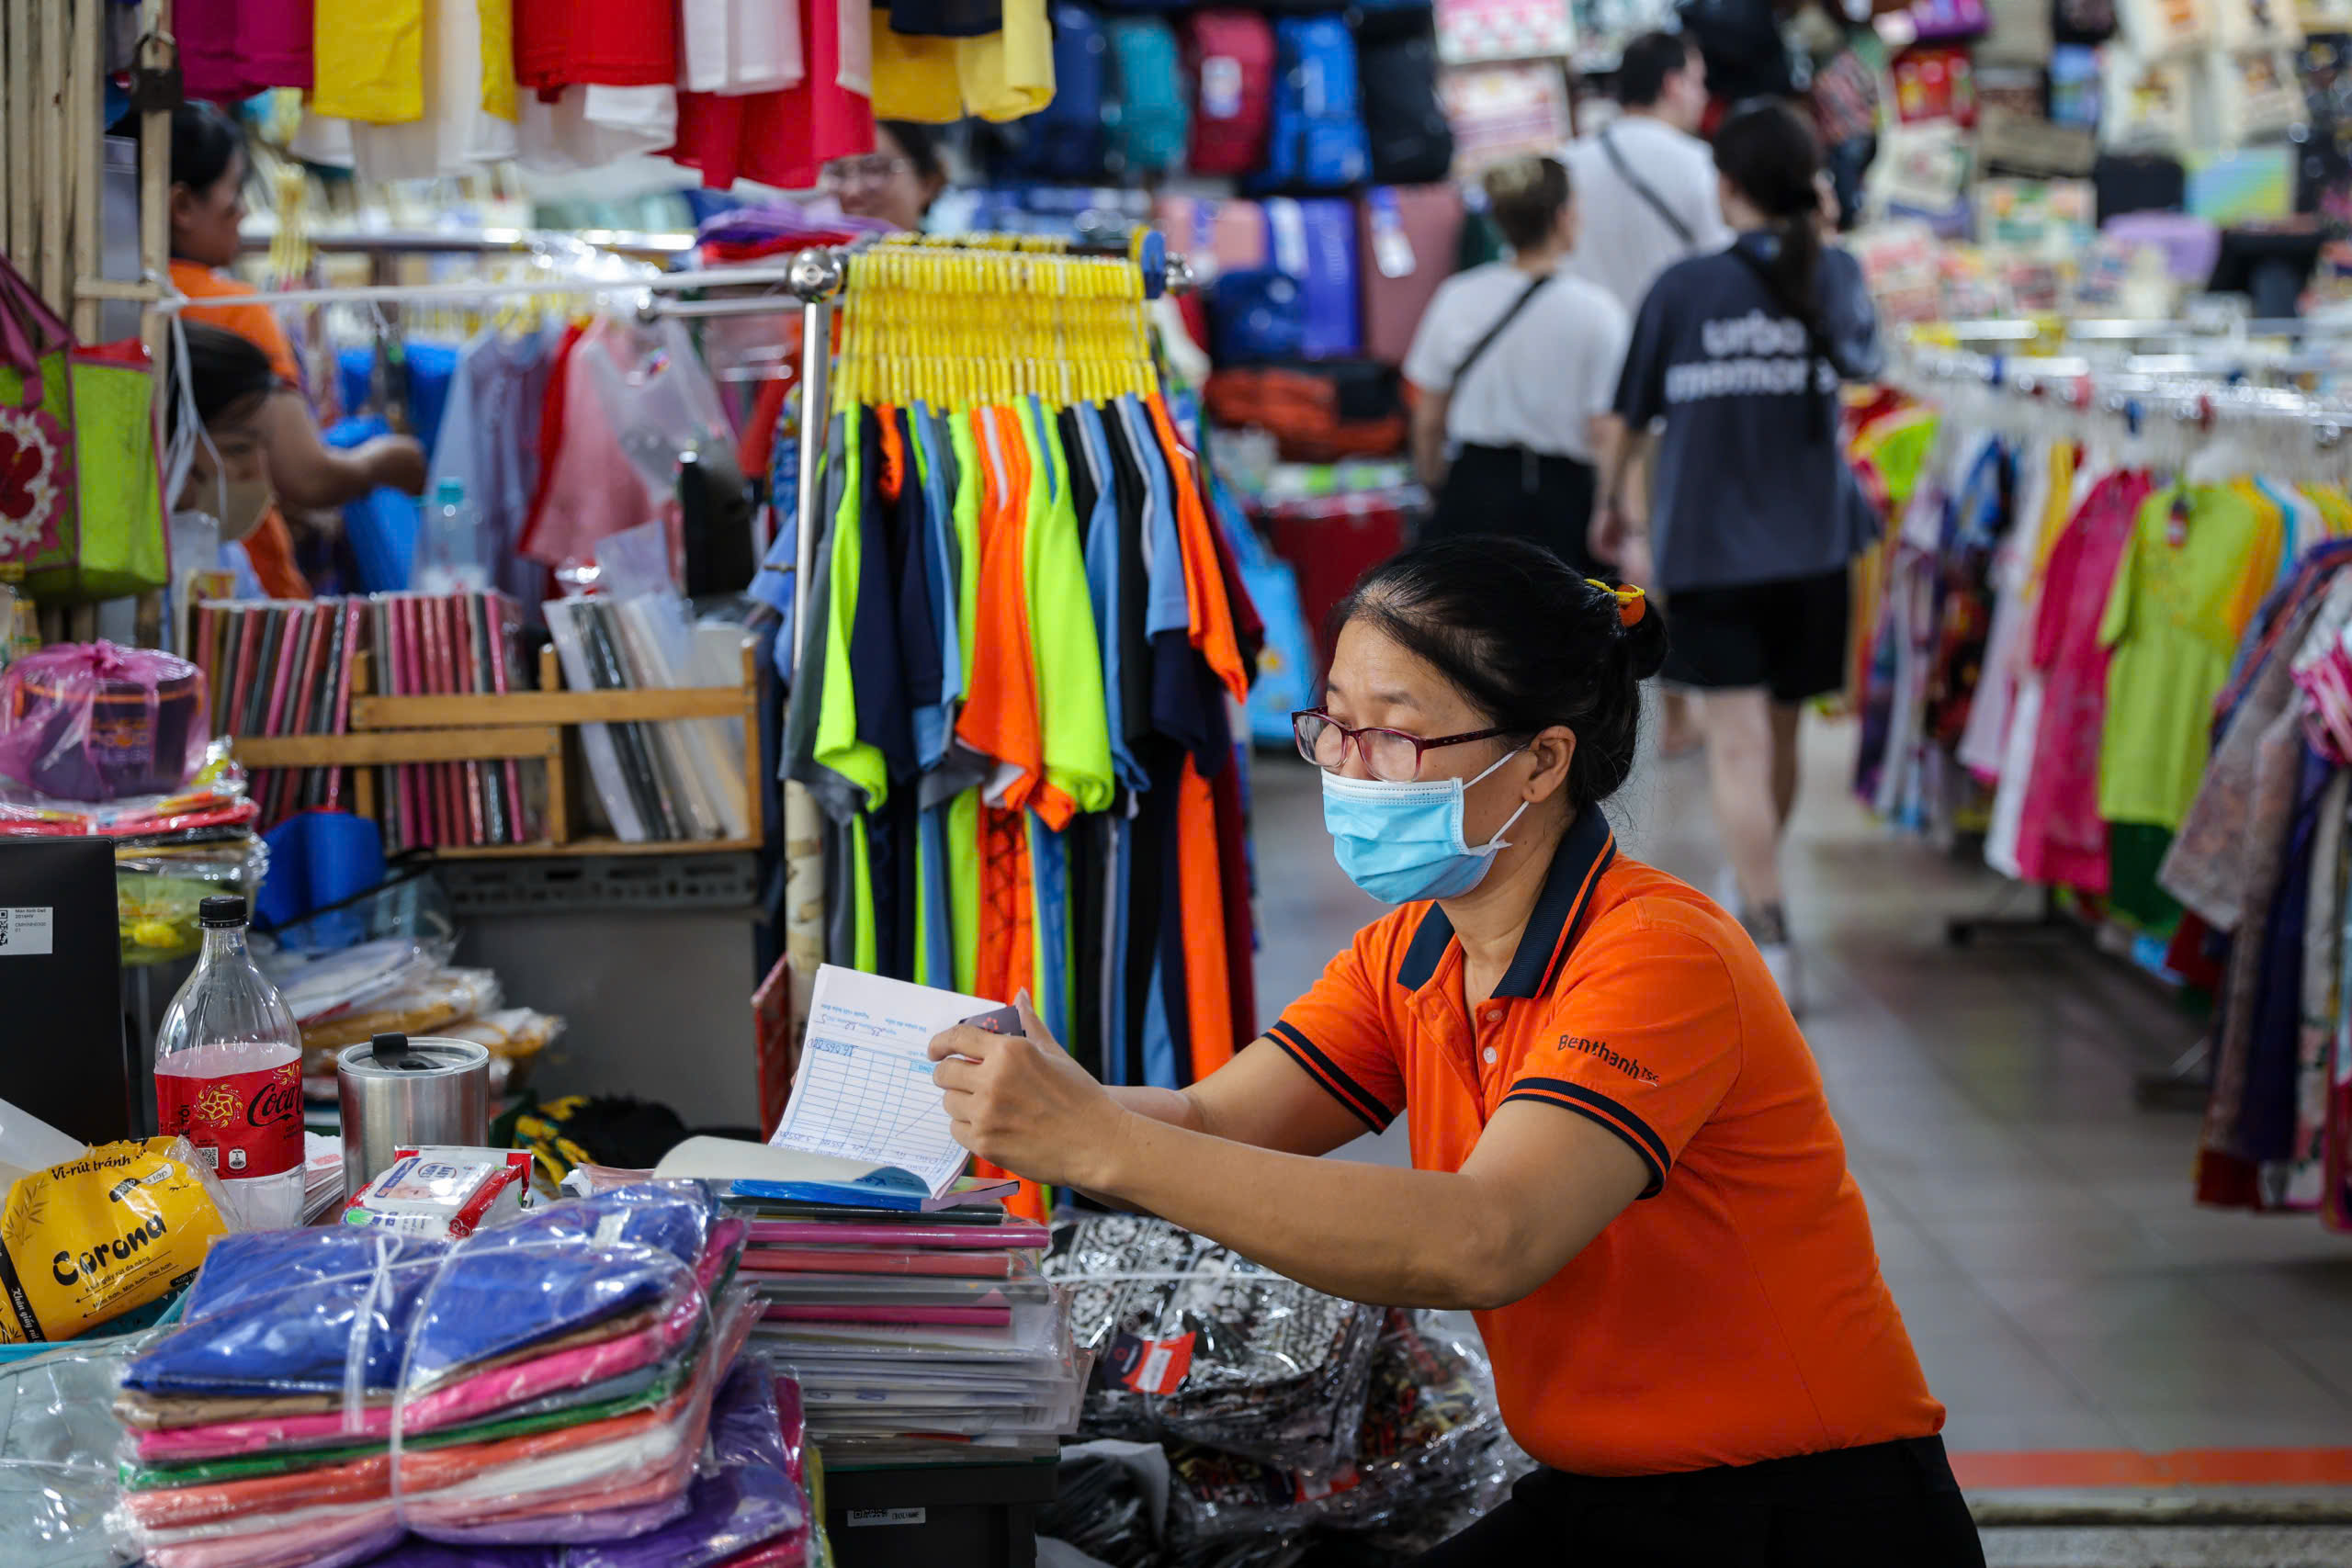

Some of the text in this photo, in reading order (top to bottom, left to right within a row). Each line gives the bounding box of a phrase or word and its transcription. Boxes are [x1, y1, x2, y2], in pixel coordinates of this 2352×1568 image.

[1557, 1034, 1640, 1079] Benthanh
[93, 1155, 130, 1172] tránh
[53, 1214, 166, 1286] Corona
